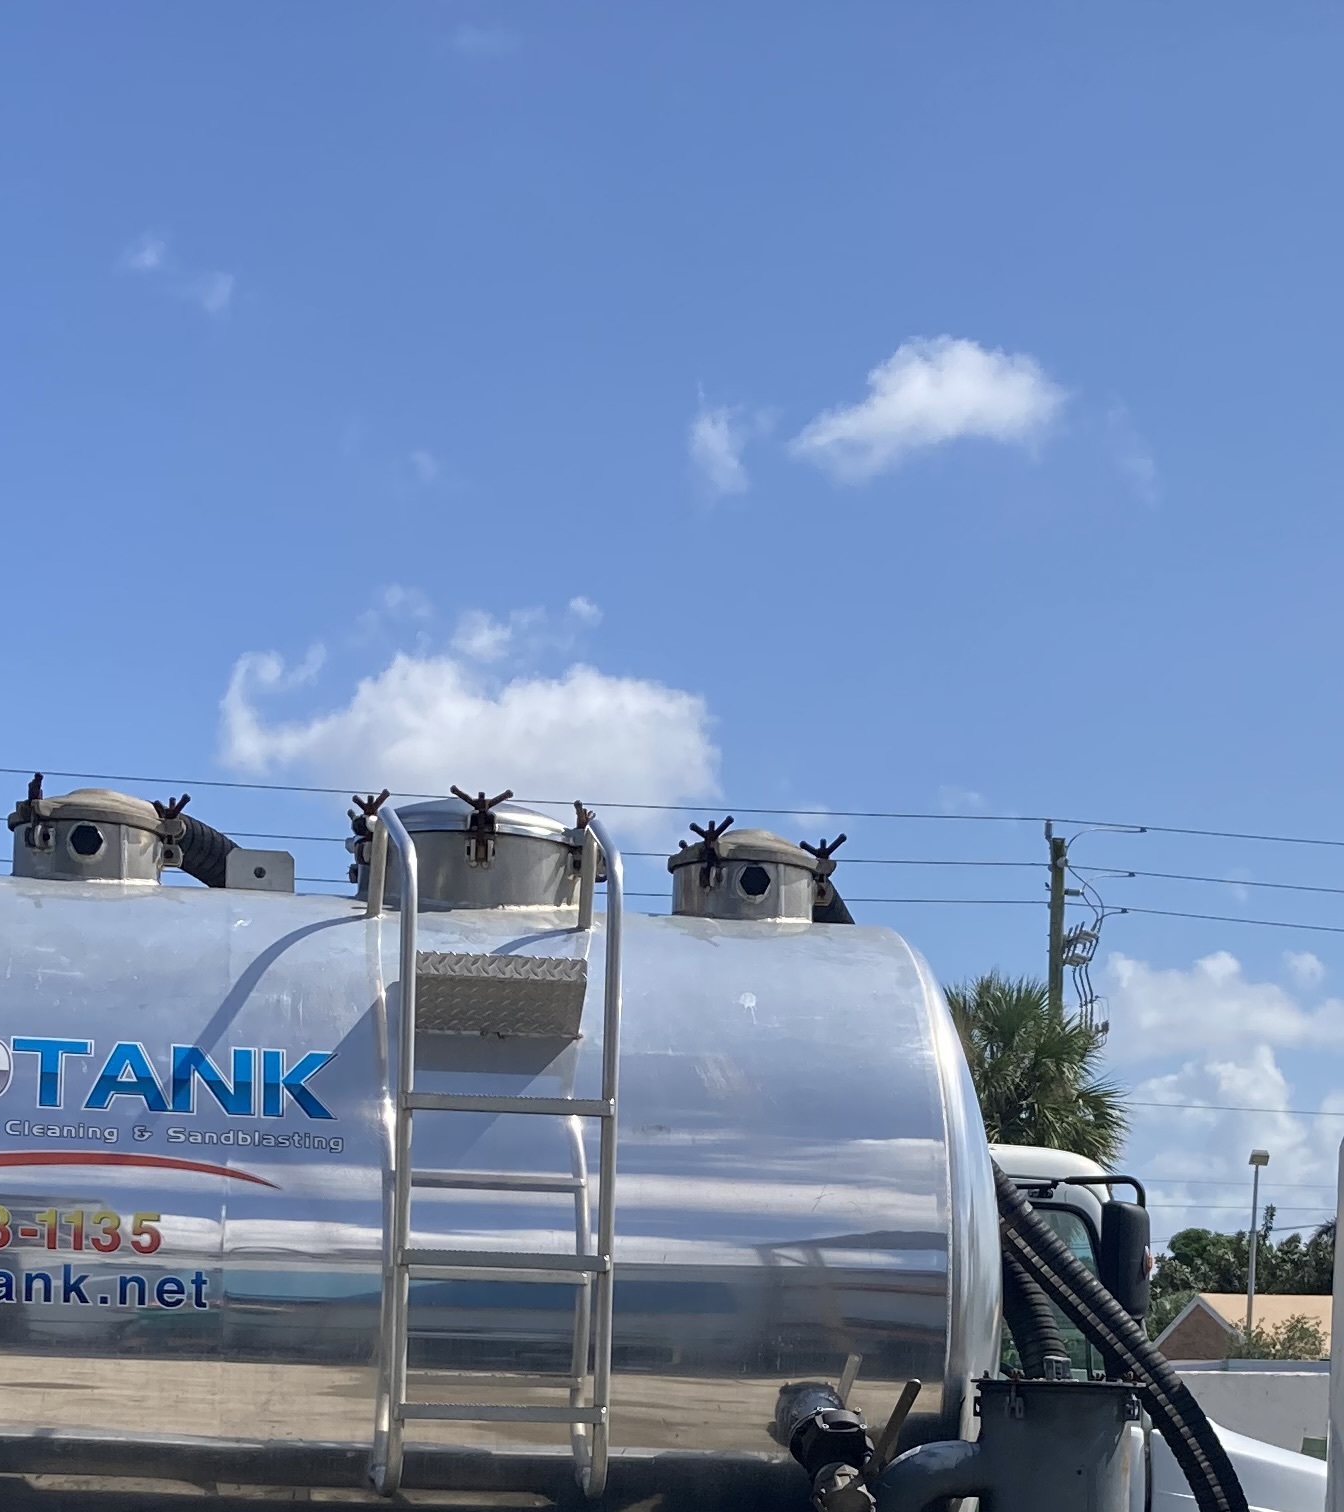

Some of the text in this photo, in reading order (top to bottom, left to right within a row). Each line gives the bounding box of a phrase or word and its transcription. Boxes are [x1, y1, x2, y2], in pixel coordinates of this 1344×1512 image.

[4, 1119, 118, 1143] Cleaning
[132, 1125, 153, 1142] &
[166, 1126, 345, 1154] Sandblasting
